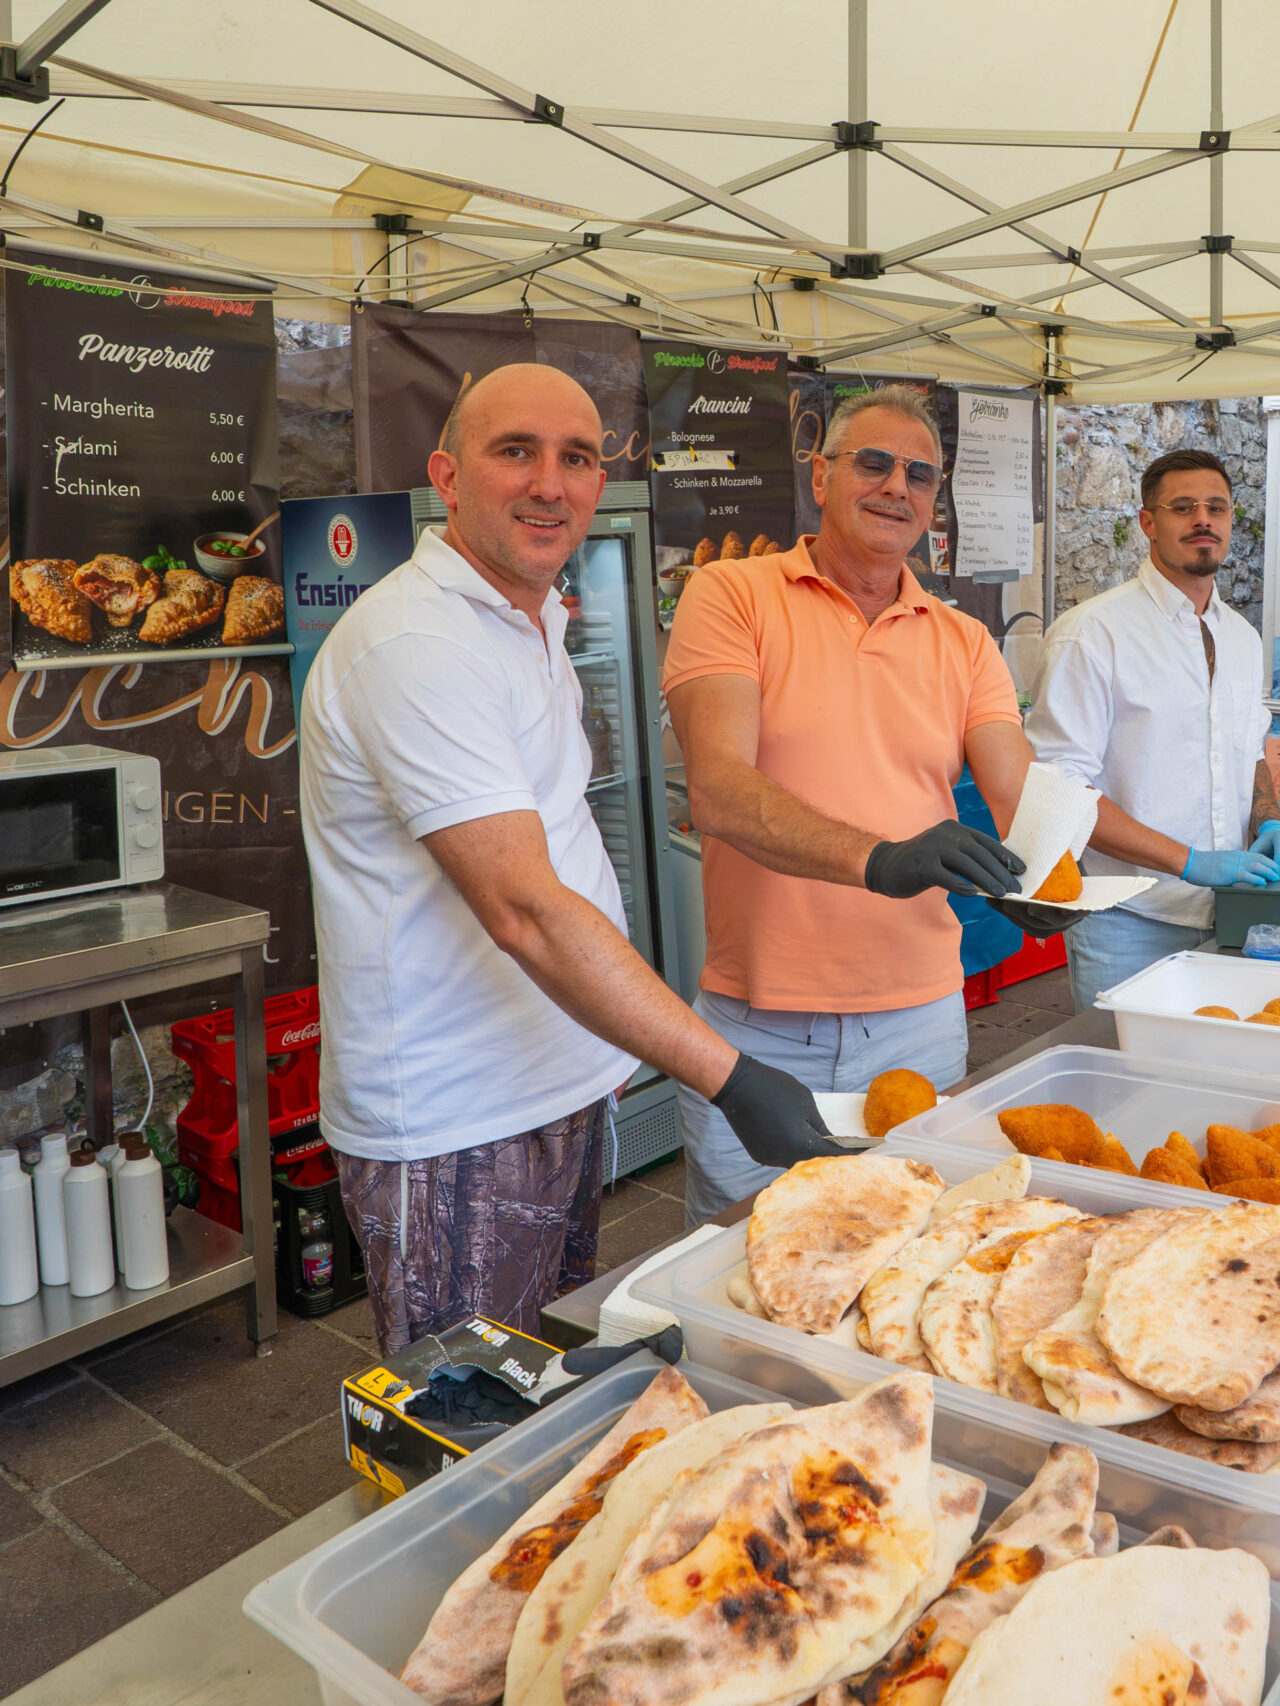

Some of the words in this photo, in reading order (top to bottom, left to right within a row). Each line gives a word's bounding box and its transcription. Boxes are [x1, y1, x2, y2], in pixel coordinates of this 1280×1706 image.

[78, 334, 215, 373] Panzerotti
[54, 394, 155, 419] Margherita
[688, 395, 753, 415] Arancini
[209, 412, 234, 425] 5,50
[236, 414, 245, 426] €
[55, 436, 118, 457] Salami
[671, 431, 715, 445] Bolognese
[210, 452, 234, 464] 6,00
[237, 453, 245, 464] €
[55, 477, 141, 498] Schinken
[674, 477, 709, 488] Schinken
[711, 477, 718, 487] &
[720, 475, 763, 487] Mozzarella
[212, 491, 235, 503] 6,00
[238, 491, 246, 502] €
[709, 507, 717, 515] Je
[719, 504, 733, 515] 3,90
[465, 1319, 511, 1348] THOR
[373, 1373, 385, 1384] L
[499, 1358, 539, 1389] Black
[347, 1394, 384, 1433] THOR
